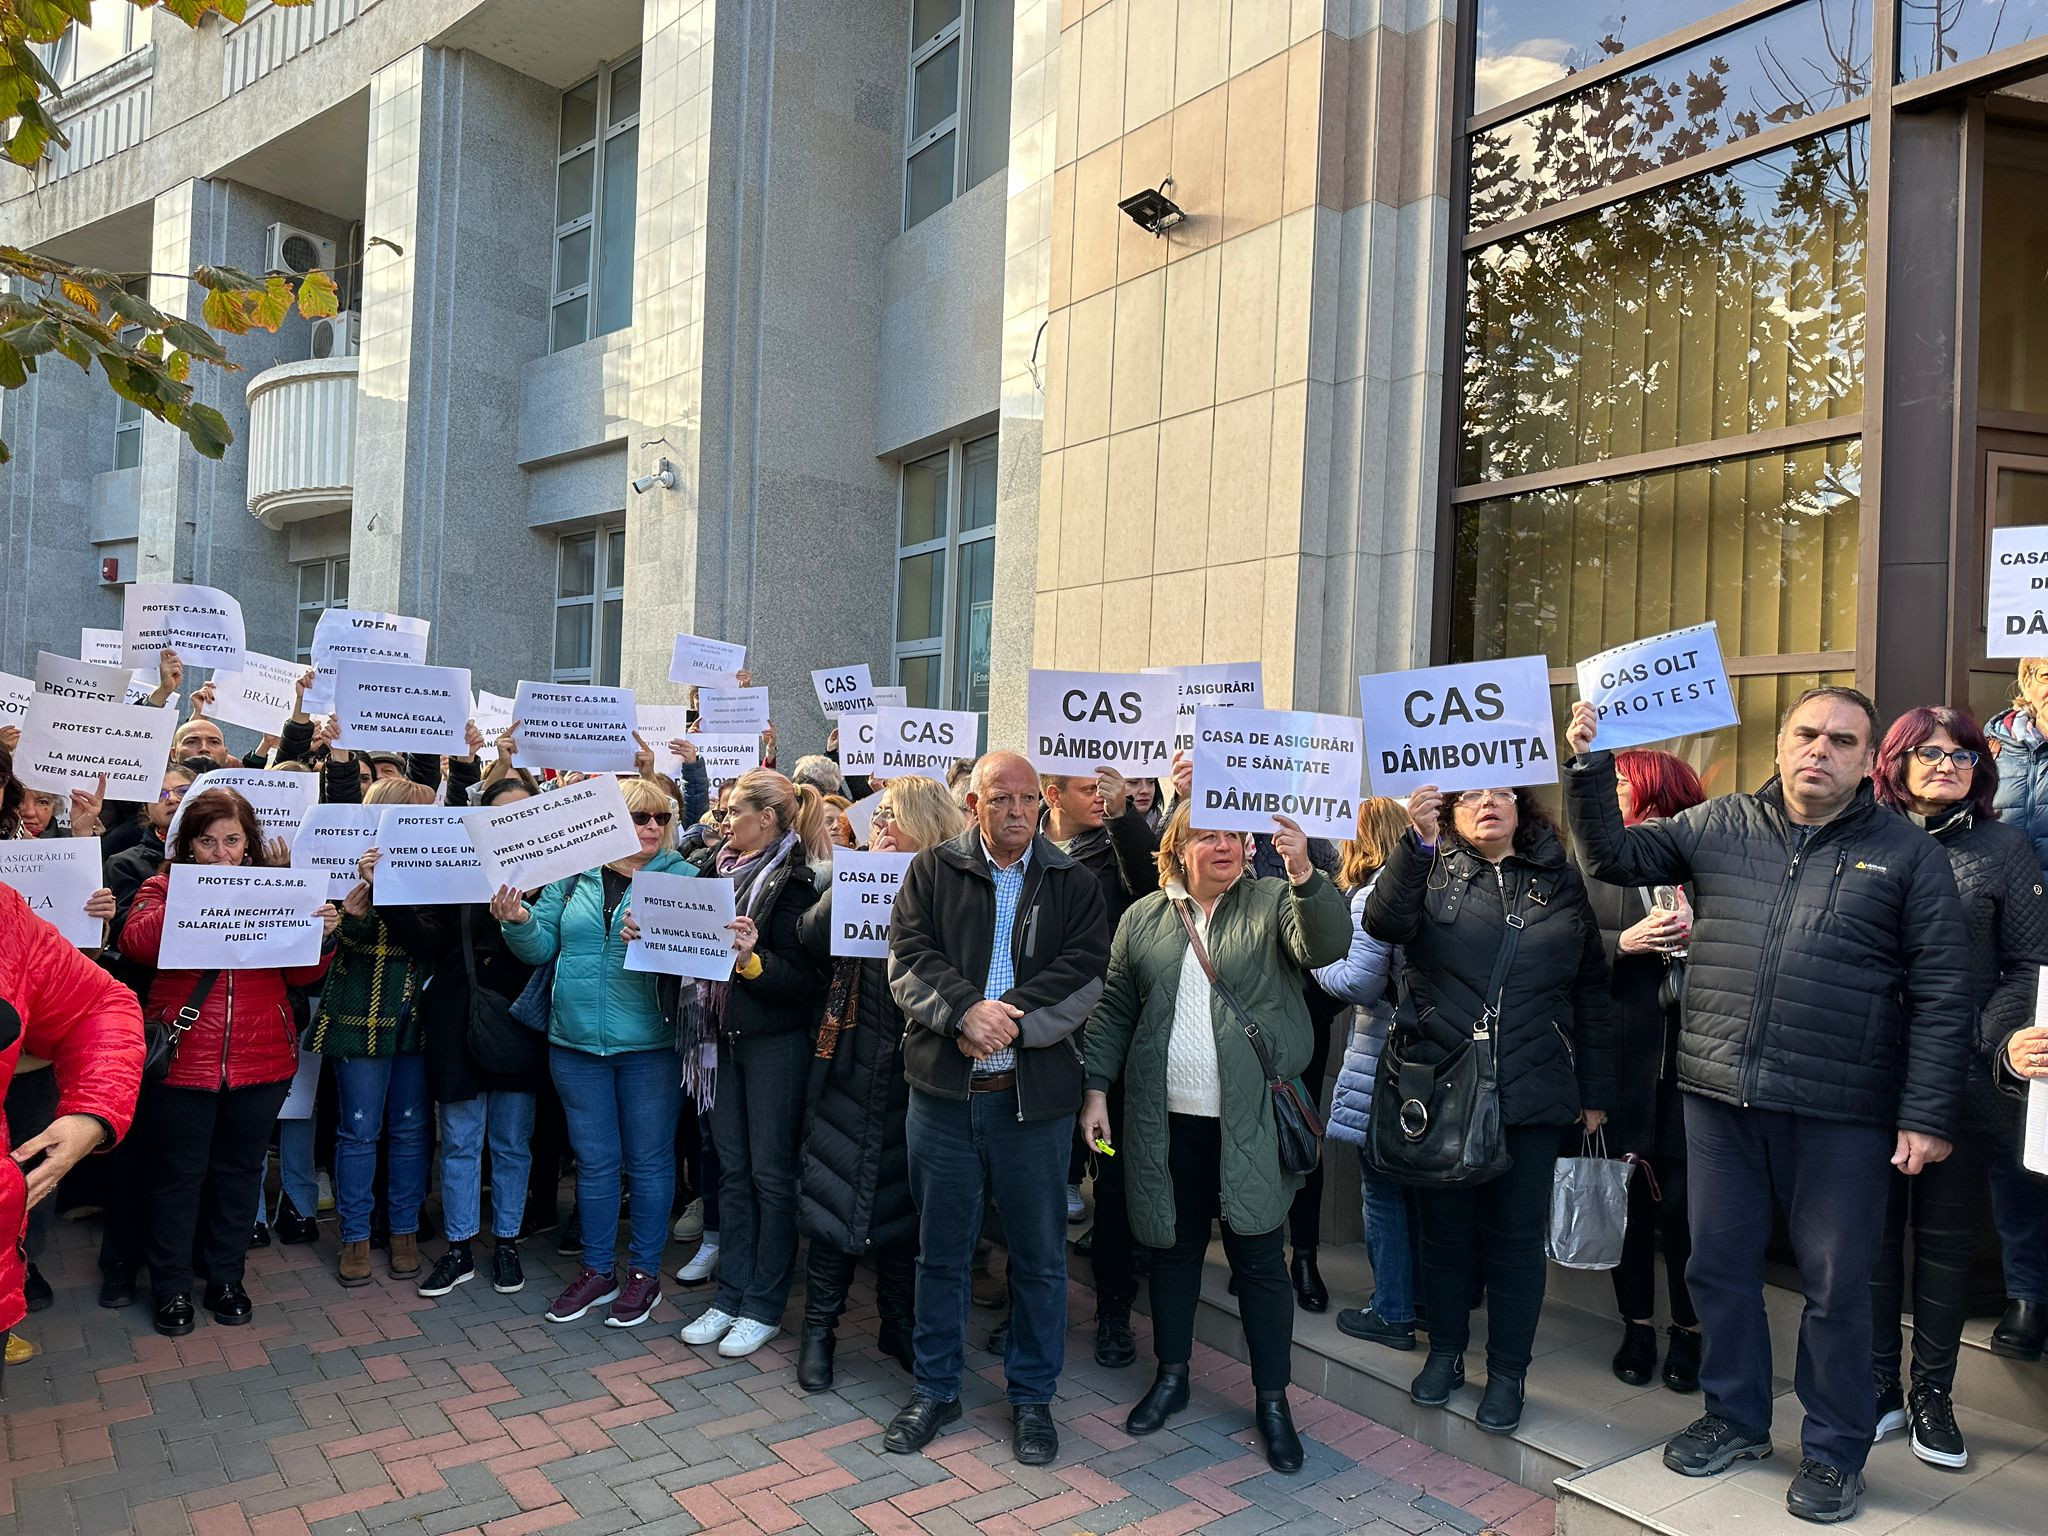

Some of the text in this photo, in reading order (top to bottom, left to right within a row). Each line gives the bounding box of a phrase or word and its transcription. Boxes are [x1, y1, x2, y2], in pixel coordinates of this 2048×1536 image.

[2000, 551, 2048, 565] CASA
[183, 606, 228, 616] C.A.S.M.B.
[351, 619, 398, 632] VREM
[139, 629, 168, 637] MEREU
[329, 645, 411, 659] PROTEST C.A.S.M.B.
[693, 660, 722, 672] BRĂILA
[1600, 650, 1698, 689] CAS OLT
[259, 671, 292, 684] SĂNĂTATE
[359, 684, 451, 697] PROTEST C.A.S.M.B.
[825, 676, 856, 693] CAS
[1186, 681, 1254, 695] ASIGURĂRI
[45, 681, 116, 702] PROTEST
[243, 689, 291, 710] BRĂILA
[532, 693, 619, 704] PROTEST C.A.S.M.B.
[1404, 682, 1505, 728] CAS
[1598, 679, 1716, 720] PROTEST
[1063, 690, 1142, 724] CAS
[375, 711, 409, 721] MUNCĂ
[412, 714, 446, 724] EGALĂ,
[52, 722, 153, 740] PROTEST C.A.S.M.B.
[351, 724, 453, 737] VREM SALARII EGALE!
[485, 727, 509, 736] ASIG
[587, 722, 627, 730] UNITARĂ
[900, 720, 954, 745] CAS
[524, 731, 626, 742] PRIVIND SALARIZAREA
[1202, 730, 1354, 753] CASA DE ASIGURĂRI
[706, 745, 754, 753] ASIGURĂRI
[48, 751, 142, 768] LA MUNCĂ EGALĂ,
[847, 751, 874, 764] DÂM
[1226, 755, 1330, 774] DE SĂNĂTATE
[34, 763, 67, 776] VREM
[112, 772, 148, 782] EGALE!
[203, 777, 299, 789] PROTEST C.A.S.M.B.
[253, 808, 290, 818] HITĂȚI
[490, 790, 596, 827] PROTEST C.A.S.M.B.
[398, 817, 444, 825] PROTEST
[315, 828, 360, 836] PROTEST
[493, 841, 525, 857] VREM
[537, 829, 566, 844] LEGE
[567, 811, 615, 835] UNITARĂ
[389, 847, 418, 855] VREM
[500, 824, 618, 868] PRIVIND SALARIZAREA
[4, 852, 60, 863] ASIGURĂRI
[63, 852, 77, 860] DE
[391, 860, 432, 868] PRIVIND
[198, 877, 307, 888] PROTEST C.A.S.M.B.
[330, 872, 356, 880] DATĂ
[839, 872, 898, 883] CASA DE
[644, 897, 716, 912] PROTEST C.A.S.M.B.
[861, 894, 879, 904] DE
[200, 907, 231, 917] FĂRĂ
[178, 919, 312, 930] SALARIALE ÎN SISTEMUL
[844, 920, 890, 940] DÂM
[224, 933, 267, 942] PUBLIC!
[662, 928, 690, 938] MUNCĂ
[692, 931, 720, 942] EGALĂ,
[644, 941, 728, 958] VREM SALARII EGALE!
